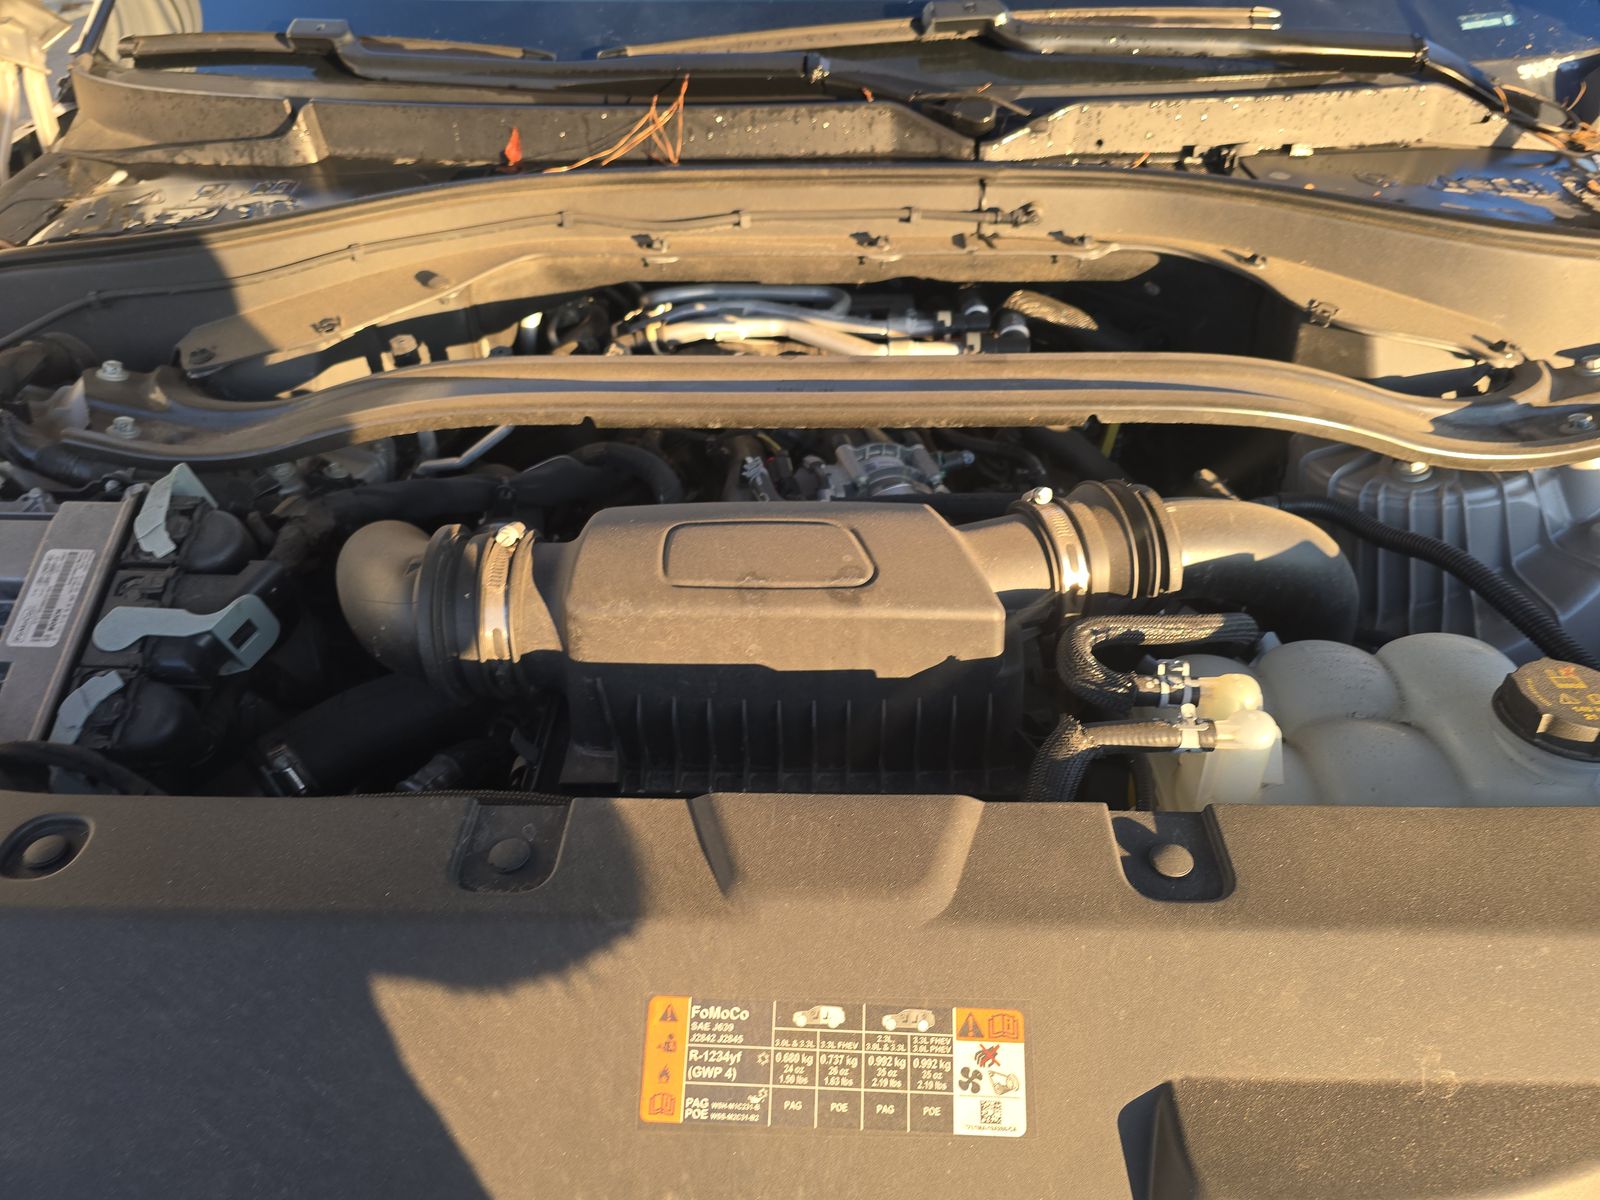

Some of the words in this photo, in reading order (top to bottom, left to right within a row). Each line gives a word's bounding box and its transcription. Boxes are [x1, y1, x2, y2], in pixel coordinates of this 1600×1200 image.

[691, 1005, 750, 1021] FoMoCo
[690, 1021, 711, 1031] SAE
[712, 1022, 735, 1032] J639
[689, 1033, 717, 1043] J2842
[717, 1034, 744, 1044] J2845
[688, 1049, 743, 1065] R-1234yf
[801, 1053, 814, 1067] kg
[820, 1053, 845, 1065] 0.737
[846, 1054, 859, 1068] kg
[868, 1055, 893, 1067] 0.992
[894, 1056, 907, 1070] kg
[783, 1064, 794, 1074] 24
[794, 1066, 805, 1074] oz
[913, 1057, 938, 1069] 0.992
[939, 1058, 952, 1072] kg
[687, 1065, 723, 1080] (GWP
[724, 1067, 737, 1082] 4)
[839, 1068, 850, 1076] oz
[887, 1069, 898, 1077] oz
[932, 1072, 944, 1080] oz
[796, 1075, 809, 1085] lbs
[840, 1076, 854, 1087] lbs
[889, 1078, 902, 1088] lbs
[934, 1080, 948, 1091] lbs
[685, 1097, 709, 1109] PAG
[784, 1100, 803, 1111] PAG
[830, 1102, 849, 1113] POE
[684, 1108, 709, 1120] POE
[876, 1104, 895, 1115] PAG
[922, 1106, 942, 1117] POE
